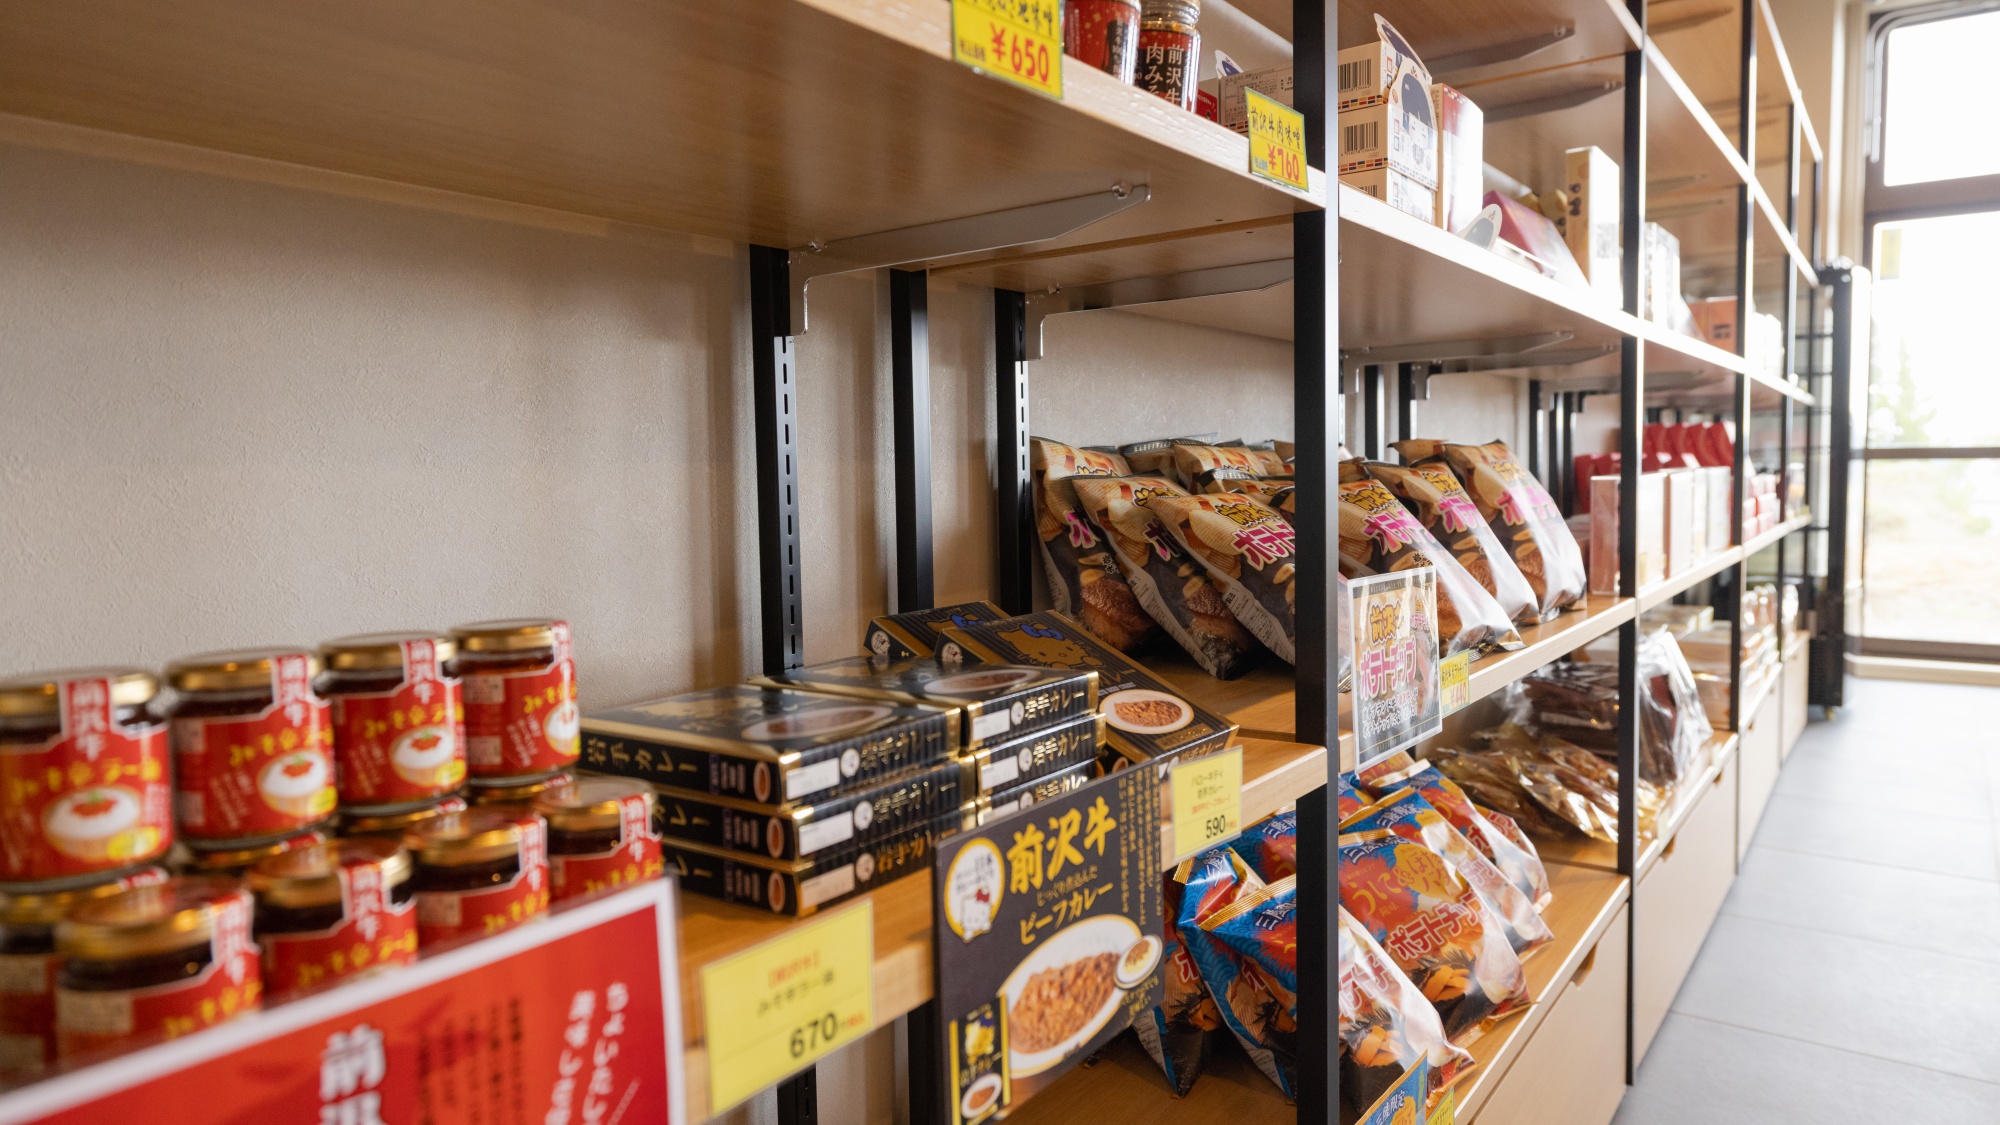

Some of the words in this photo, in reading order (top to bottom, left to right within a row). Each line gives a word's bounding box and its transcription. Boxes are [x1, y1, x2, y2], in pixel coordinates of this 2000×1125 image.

[990, 21, 1050, 84] ¥650
[1165, 44, 1184, 107] 前沢牛
[1250, 106, 1301, 150] 前沢牛肉味噌
[1267, 143, 1300, 181] ¥760
[408, 640, 435, 705] 前沢牛
[1360, 637, 1417, 700] ポテトチップ
[1024, 689, 1085, 720] 岩手カレー
[587, 736, 698, 774] 岩手カレー
[860, 730, 942, 771] 岩手カレー
[1033, 731, 1092, 767] 岩手カレー
[874, 781, 957, 824] 岩手カレー
[627, 798, 648, 863] 前沢牛
[1006, 795, 1117, 895] 前沢牛
[1206, 814, 1226, 839] 590
[1020, 882, 1114, 945] ビーフカレー
[1378, 901, 1399, 917] 風味
[787, 1011, 840, 1061] 670
